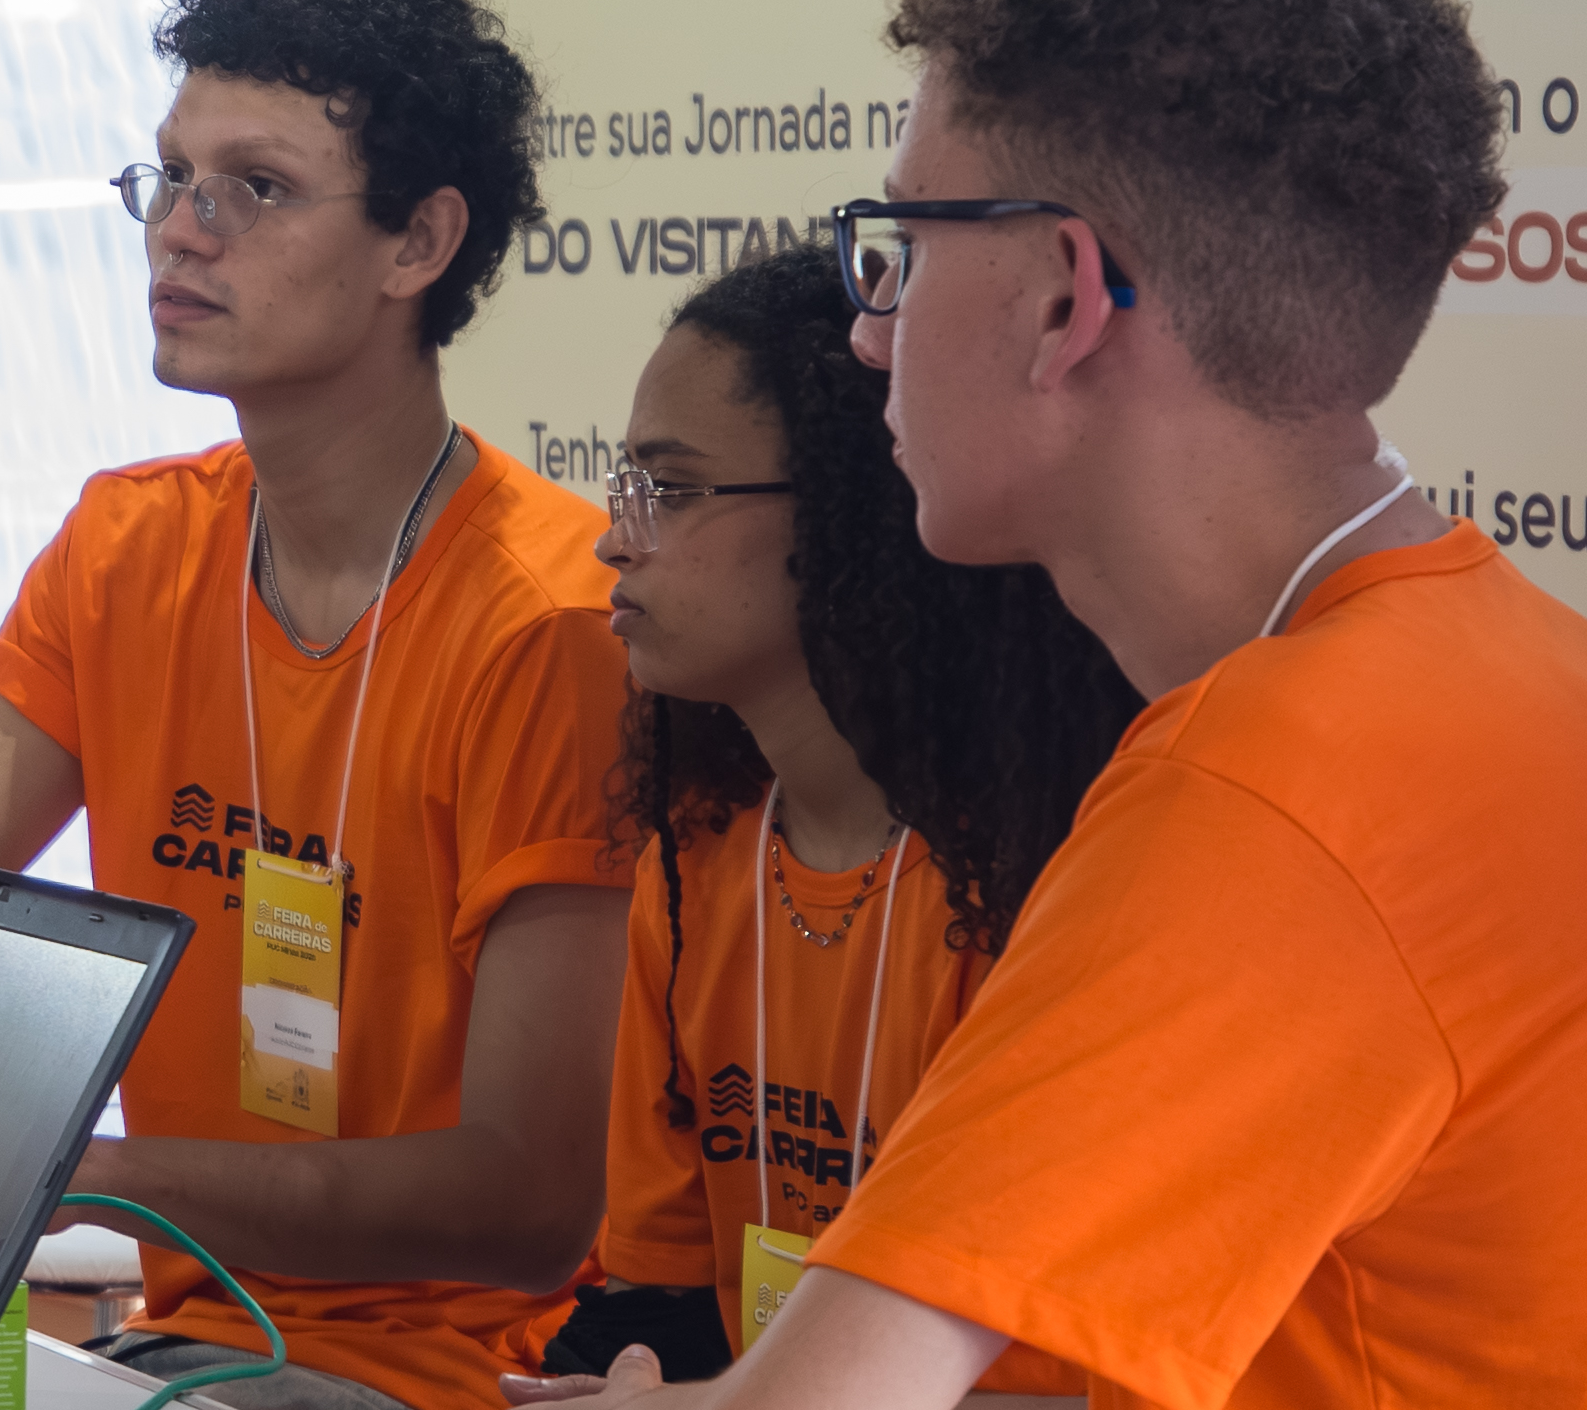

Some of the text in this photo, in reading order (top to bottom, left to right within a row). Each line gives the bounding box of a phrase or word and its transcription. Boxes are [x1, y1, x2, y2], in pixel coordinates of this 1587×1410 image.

[609, 109, 672, 158] sua
[685, 88, 852, 156] Jornada
[1542, 76, 1580, 135] o
[524, 216, 592, 276] DO
[253, 920, 333, 954] CARREIRAS
[273, 906, 313, 930] FEIRA
